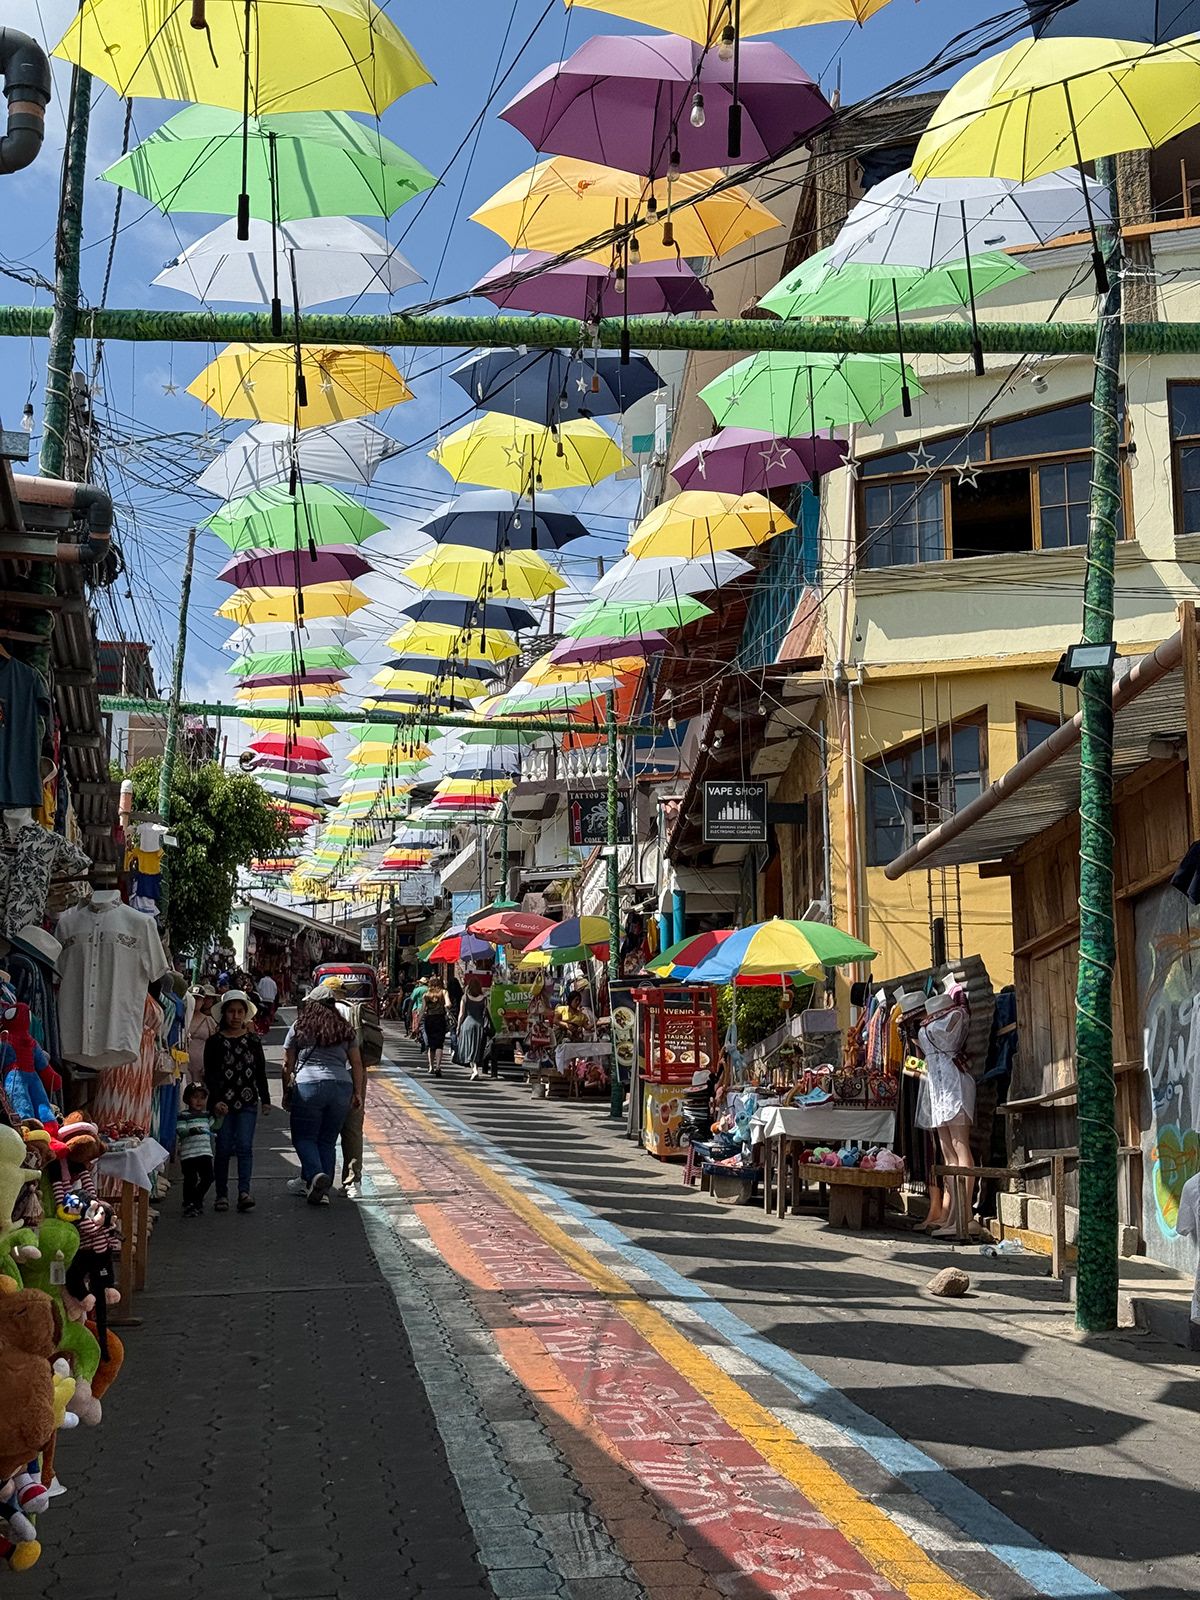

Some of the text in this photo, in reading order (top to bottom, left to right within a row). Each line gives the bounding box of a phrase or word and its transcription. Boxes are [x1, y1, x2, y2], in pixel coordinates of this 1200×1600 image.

[570, 792, 599, 800] TATTOO
[708, 787, 763, 796] VAPE SHOP
[504, 989, 534, 1002] Sunse
